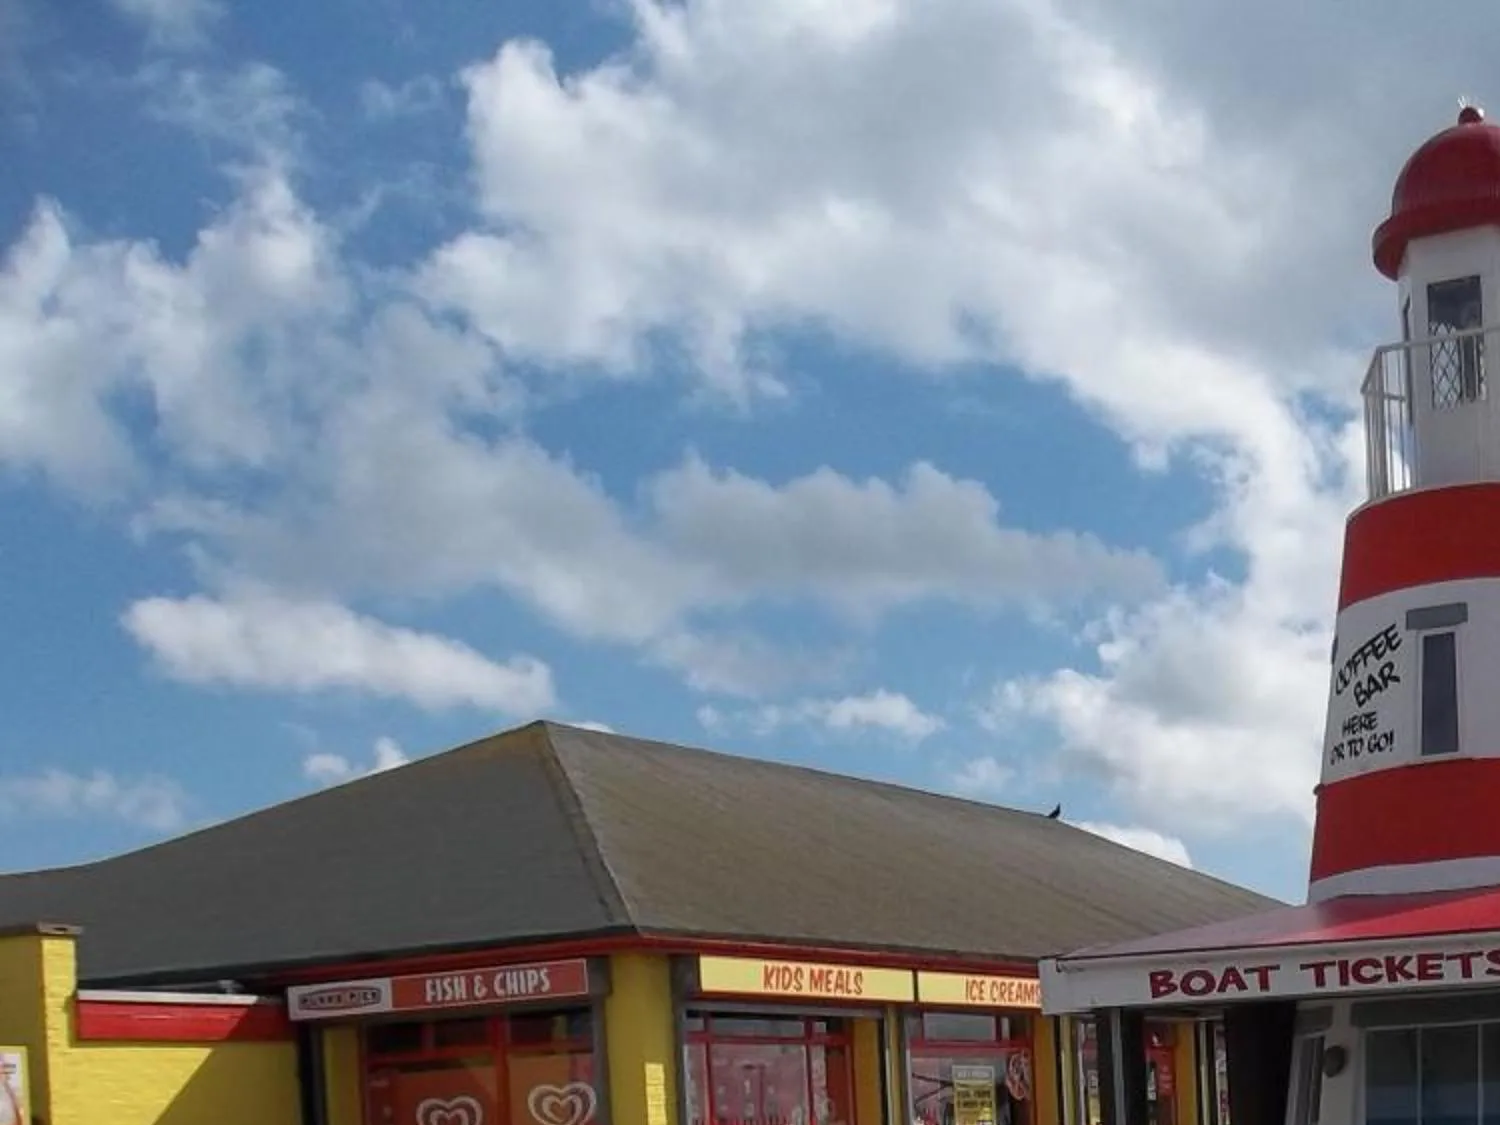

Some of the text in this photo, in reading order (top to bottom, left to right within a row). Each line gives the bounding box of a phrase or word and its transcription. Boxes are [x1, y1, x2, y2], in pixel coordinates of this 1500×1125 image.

[1335, 623, 1402, 695] COFFEE
[1353, 661, 1400, 708] BAR
[1342, 711, 1379, 737] HERE
[1330, 728, 1395, 766] OR TO GO!
[425, 967, 551, 1003] FISH & CHIPS
[763, 963, 863, 995] KIDS MEALS
[965, 977, 986, 1001] ICE
[1149, 964, 1280, 999] BOAT
